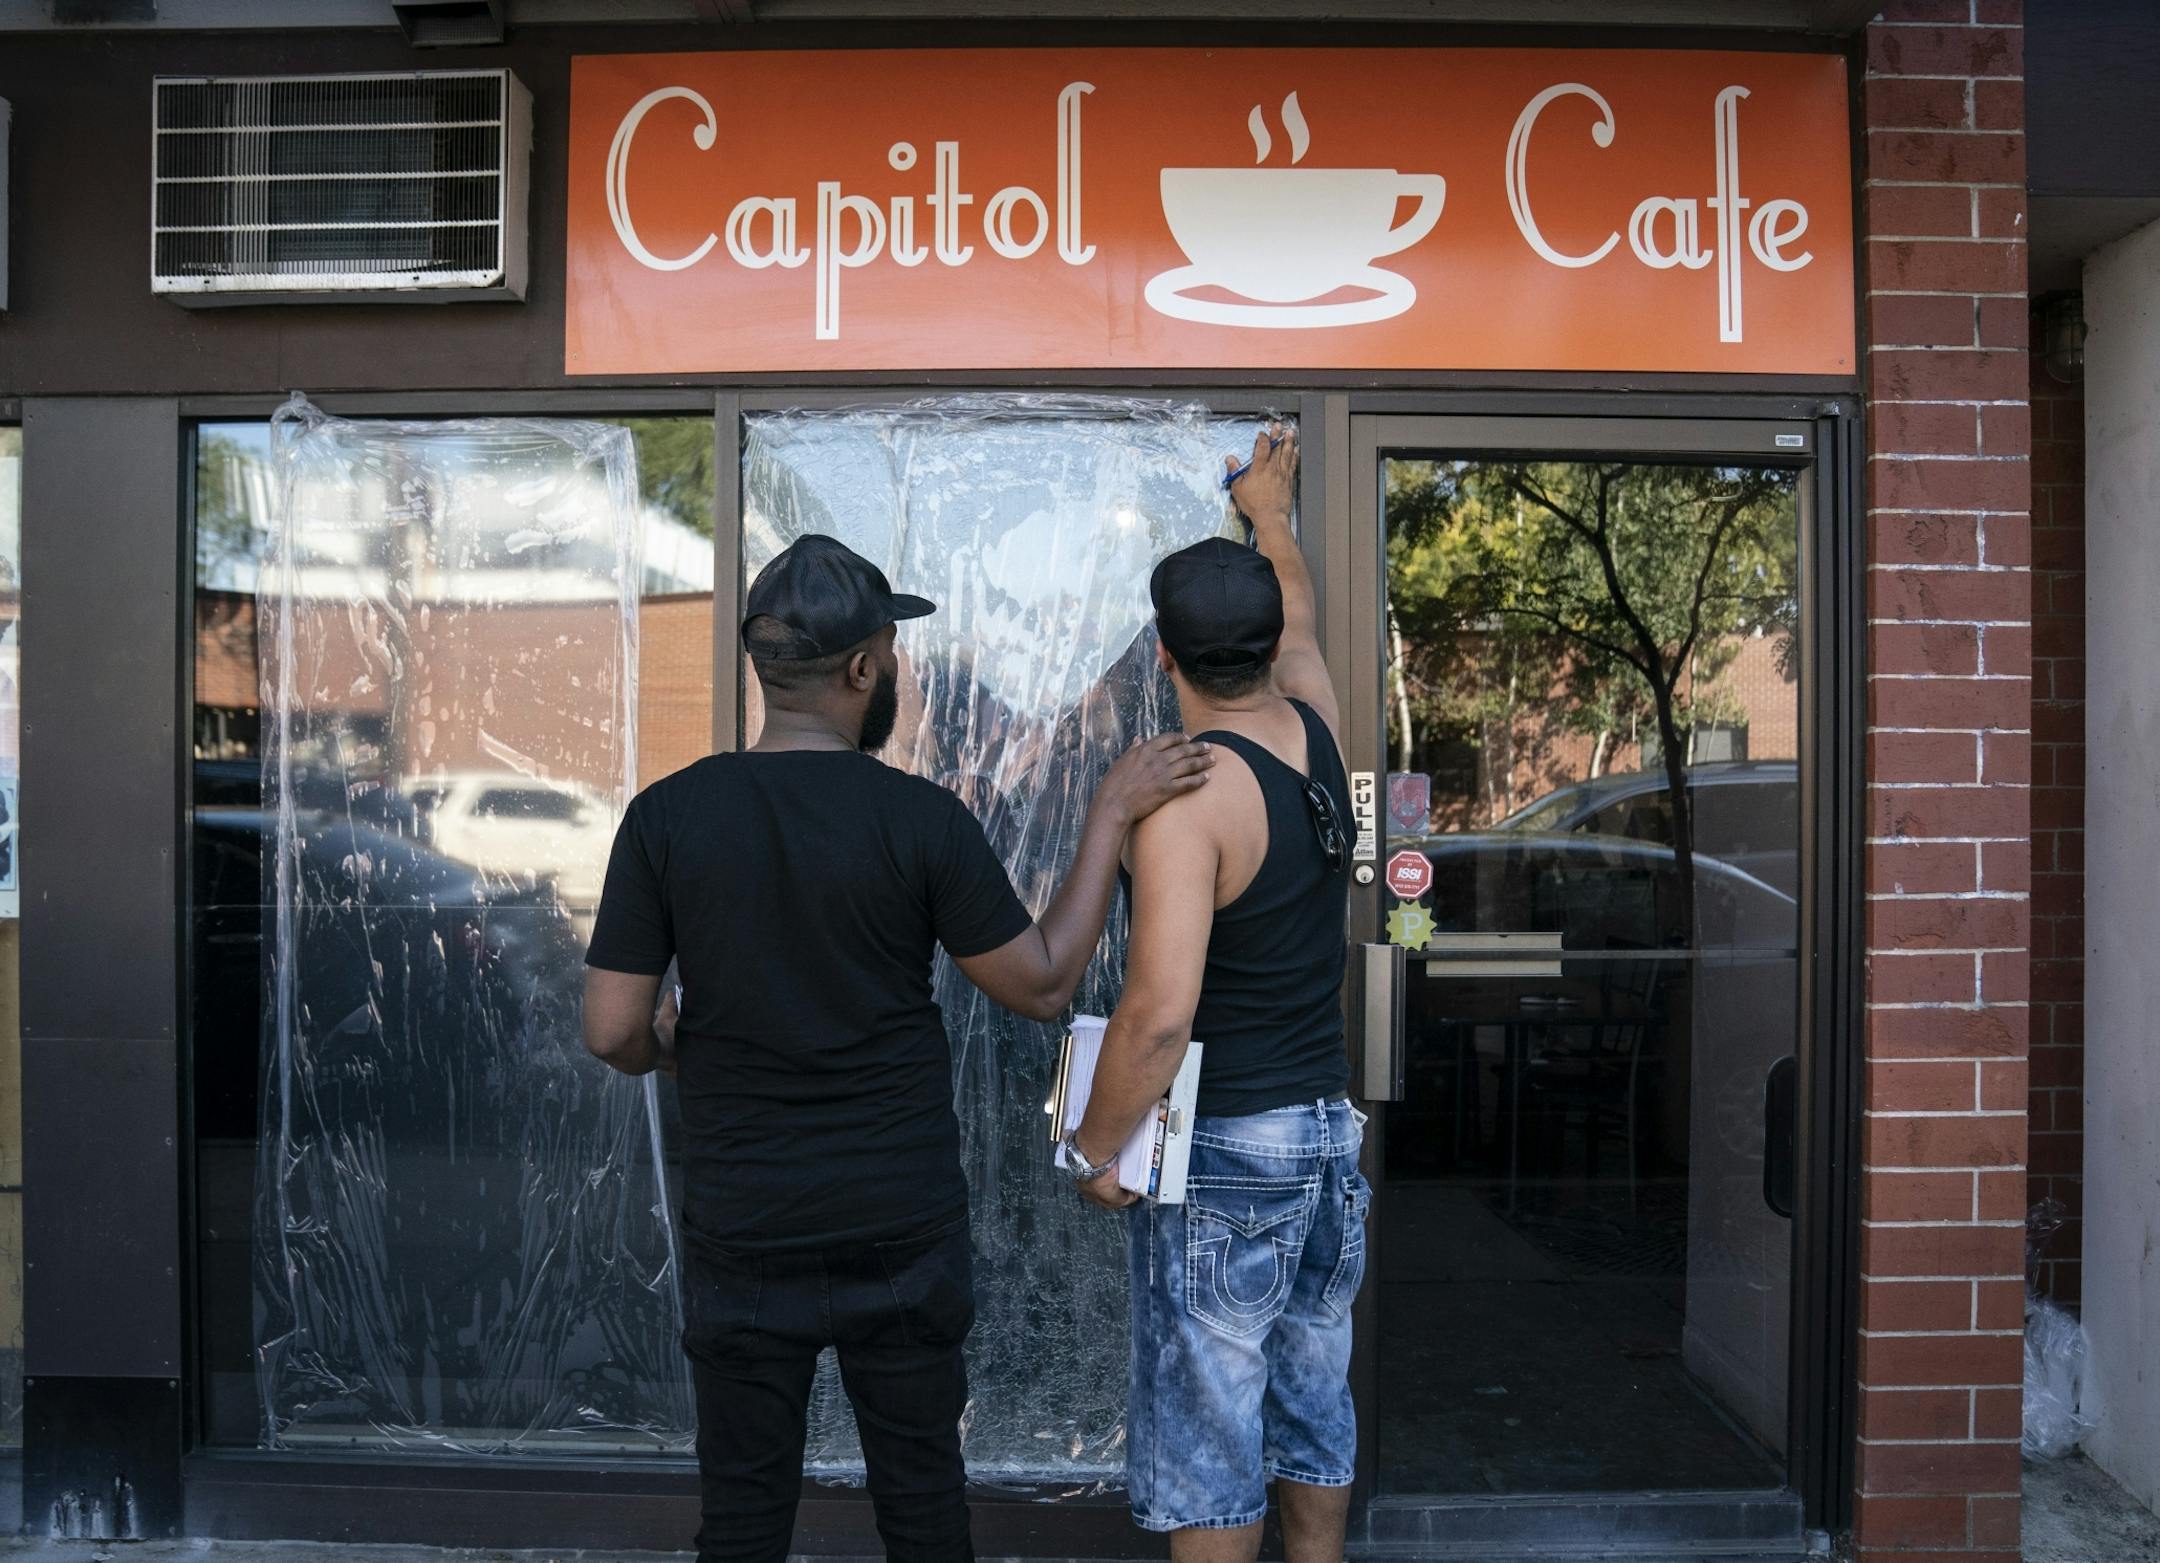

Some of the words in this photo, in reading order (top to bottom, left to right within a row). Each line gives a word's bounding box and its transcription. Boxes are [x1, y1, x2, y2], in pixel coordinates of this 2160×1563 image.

[605, 81, 1097, 340] Capitol
[1505, 82, 1814, 343] Cafe
[1354, 778, 1373, 832] PULL
[1396, 867, 1422, 880] ISSI
[1400, 912, 1424, 940] P
